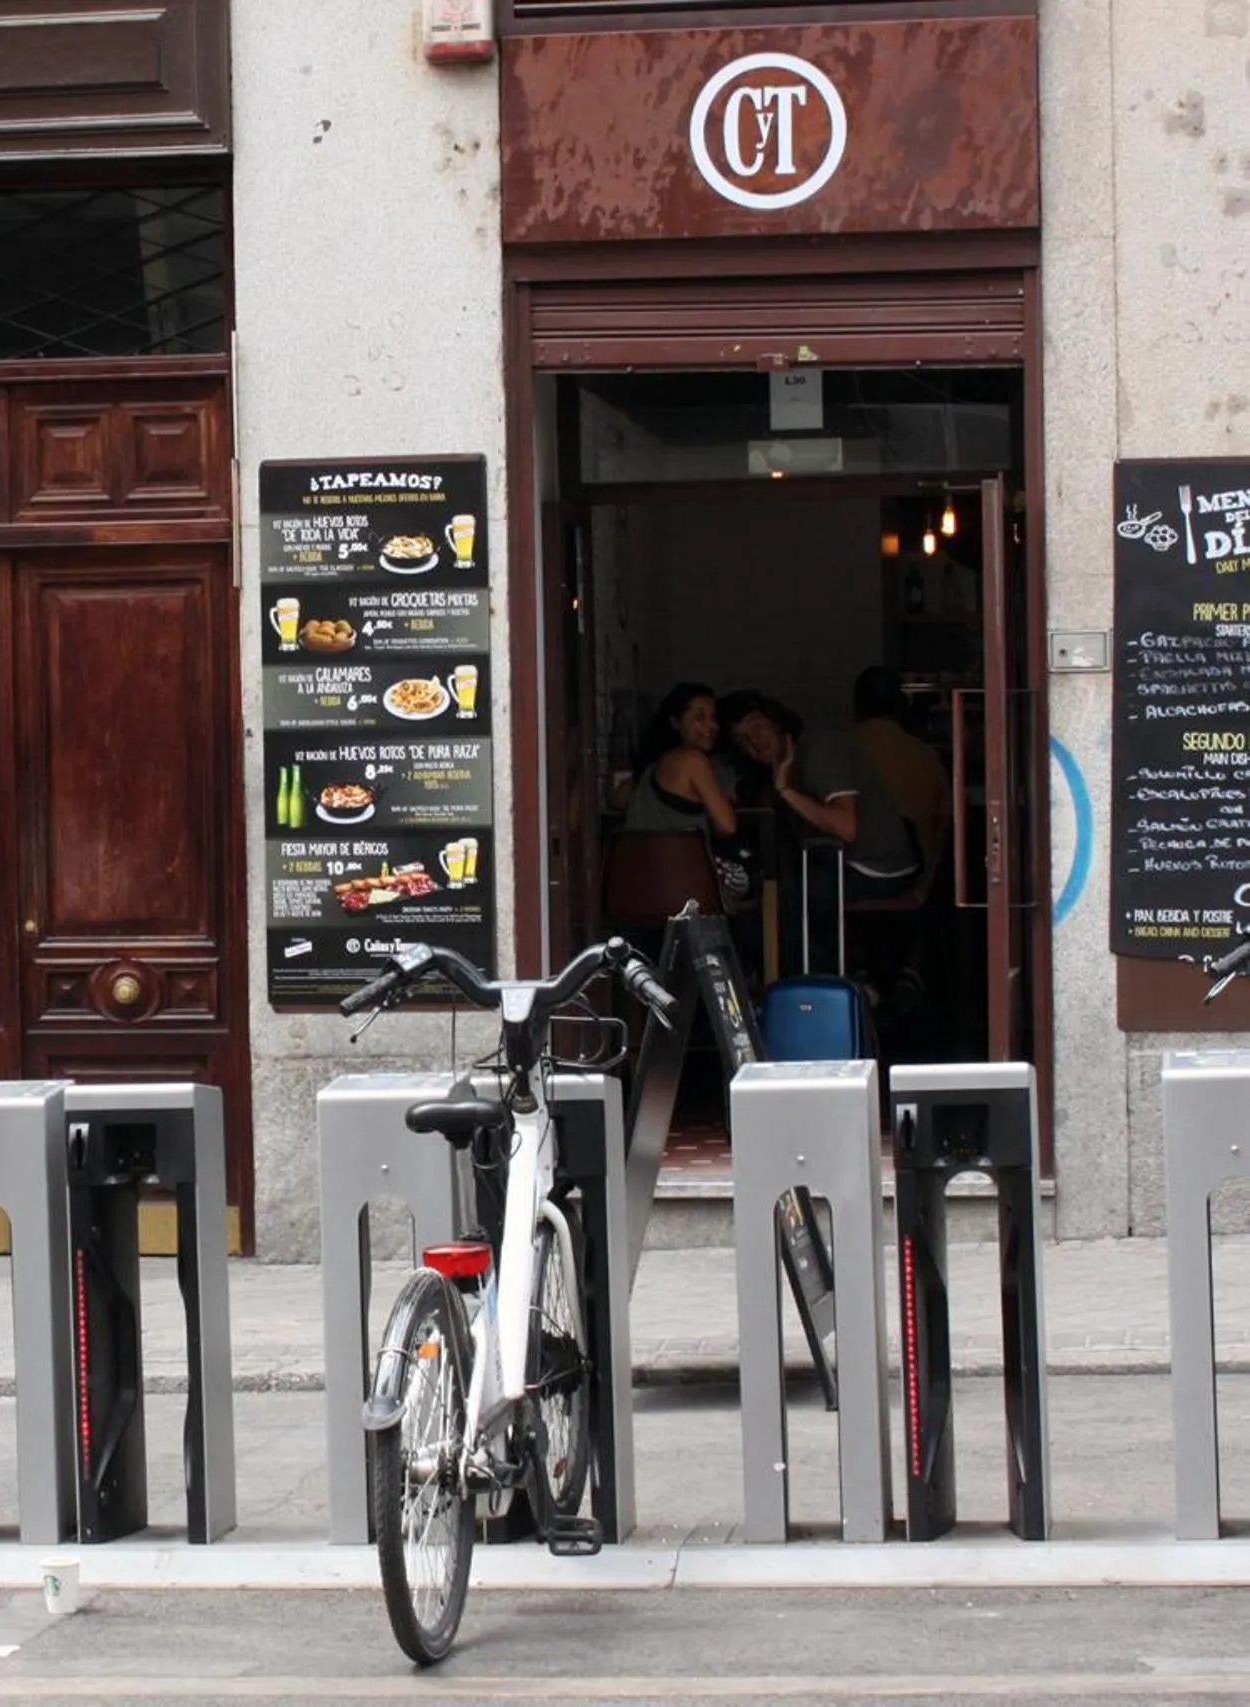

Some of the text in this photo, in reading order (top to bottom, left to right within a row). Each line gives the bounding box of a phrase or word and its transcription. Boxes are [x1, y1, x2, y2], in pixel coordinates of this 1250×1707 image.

[723, 85, 807, 176] CyT
[310, 473, 443, 491] ¿TAPEAMOS?
[312, 515, 344, 528] HUEVOS
[1204, 522, 1250, 559] DÍ
[391, 592, 445, 607] CROQUETAS
[1193, 603, 1238, 621] PRIMER
[316, 666, 373, 682] CALAMARES
[1183, 732, 1245, 750] SEGUNDO
[339, 747, 375, 761] HUEVOS
[379, 746, 406, 760] ROTOS
[428, 745, 450, 759] PURA
[1203, 753, 1229, 765] MAIN
[281, 840, 389, 857] FIESTA MAYOR DE IBÉRICOS
[1157, 909, 1190, 922] BEBIDA
[1193, 909, 1201, 922] Y
[1203, 910, 1234, 923] POSTRE
